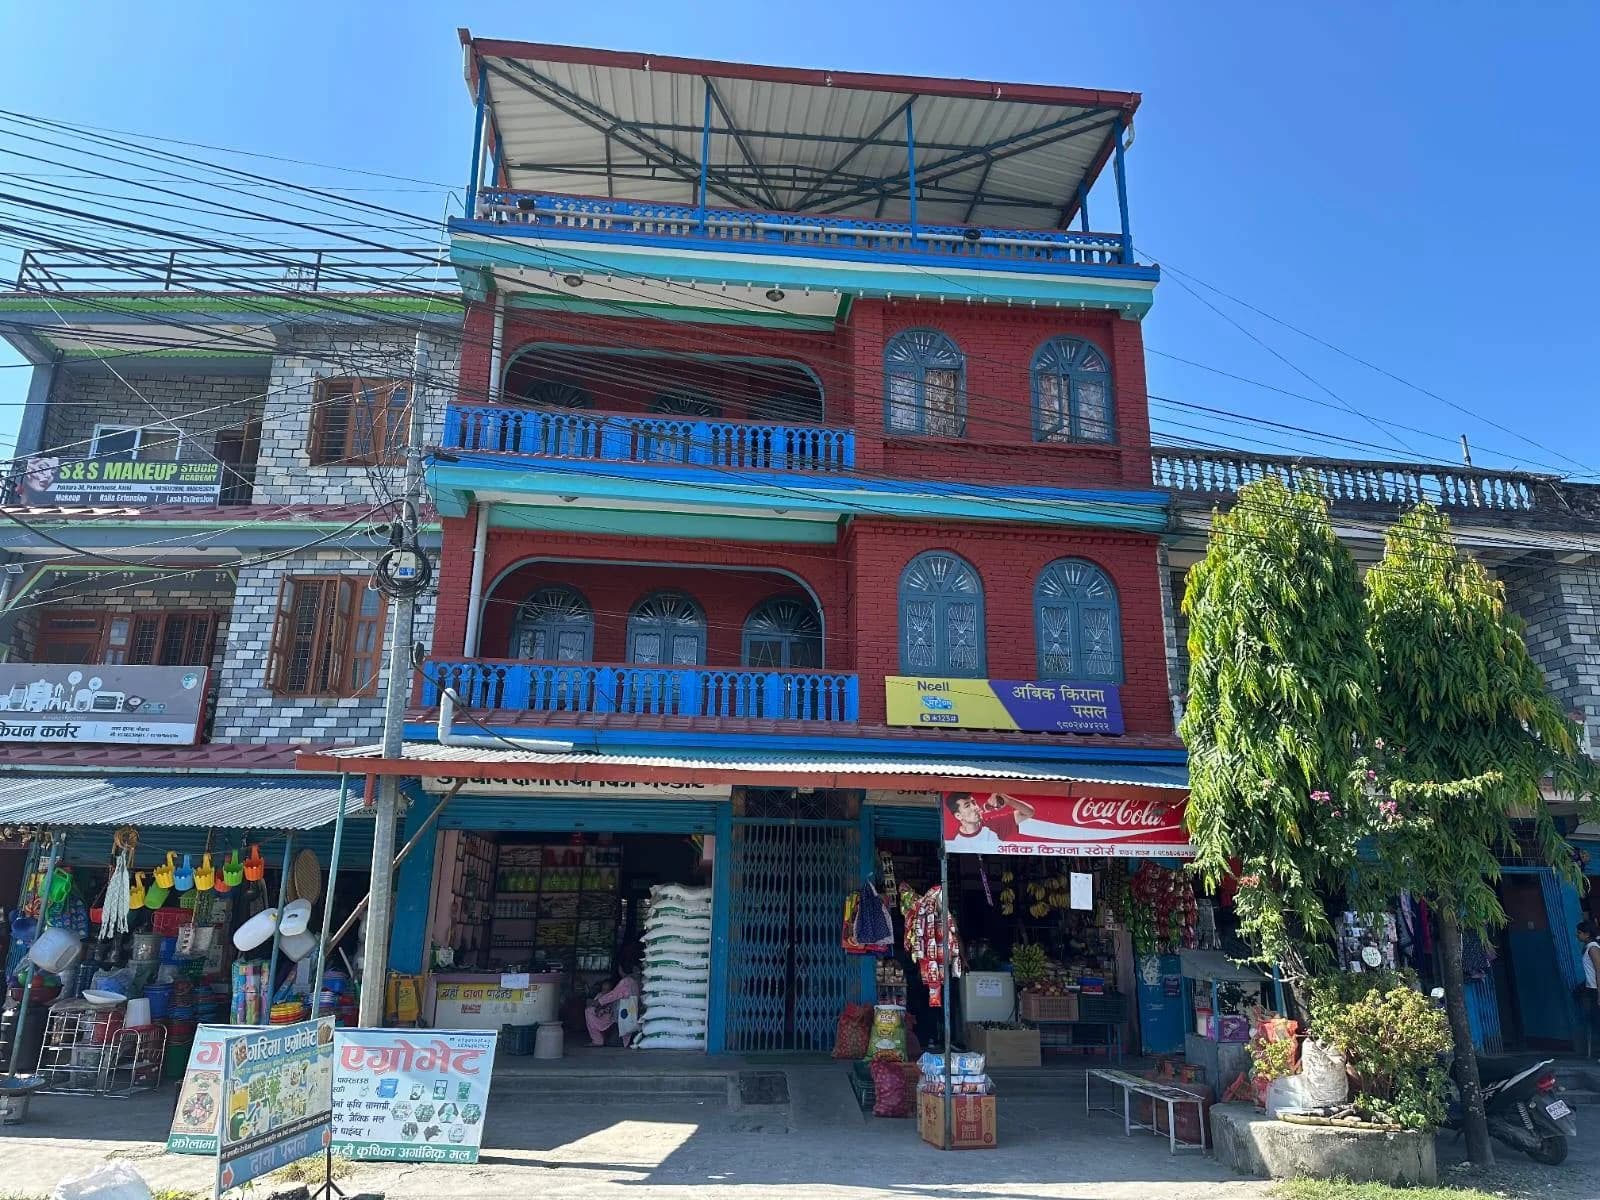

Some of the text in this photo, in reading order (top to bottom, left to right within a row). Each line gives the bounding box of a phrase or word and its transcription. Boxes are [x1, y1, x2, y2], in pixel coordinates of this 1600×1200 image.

[103, 462, 178, 481] MAKEUP
[181, 463, 218, 473] STUDIO
[180, 474, 216, 482] ACADEMY
[917, 680, 950, 691] Ncell
[1011, 683, 1105, 703] अबिक किराना
[1070, 704, 1107, 719] पसल
[40, 722, 81, 738] कर्नर
[1072, 797, 1162, 826] Coca-Cola
[997, 844, 1033, 855] अबिक
[1038, 844, 1080, 855] किराना
[248, 1036, 282, 1061] गरिमा
[356, 1144, 396, 1158] कृषिका
[449, 1149, 471, 1161] मल
